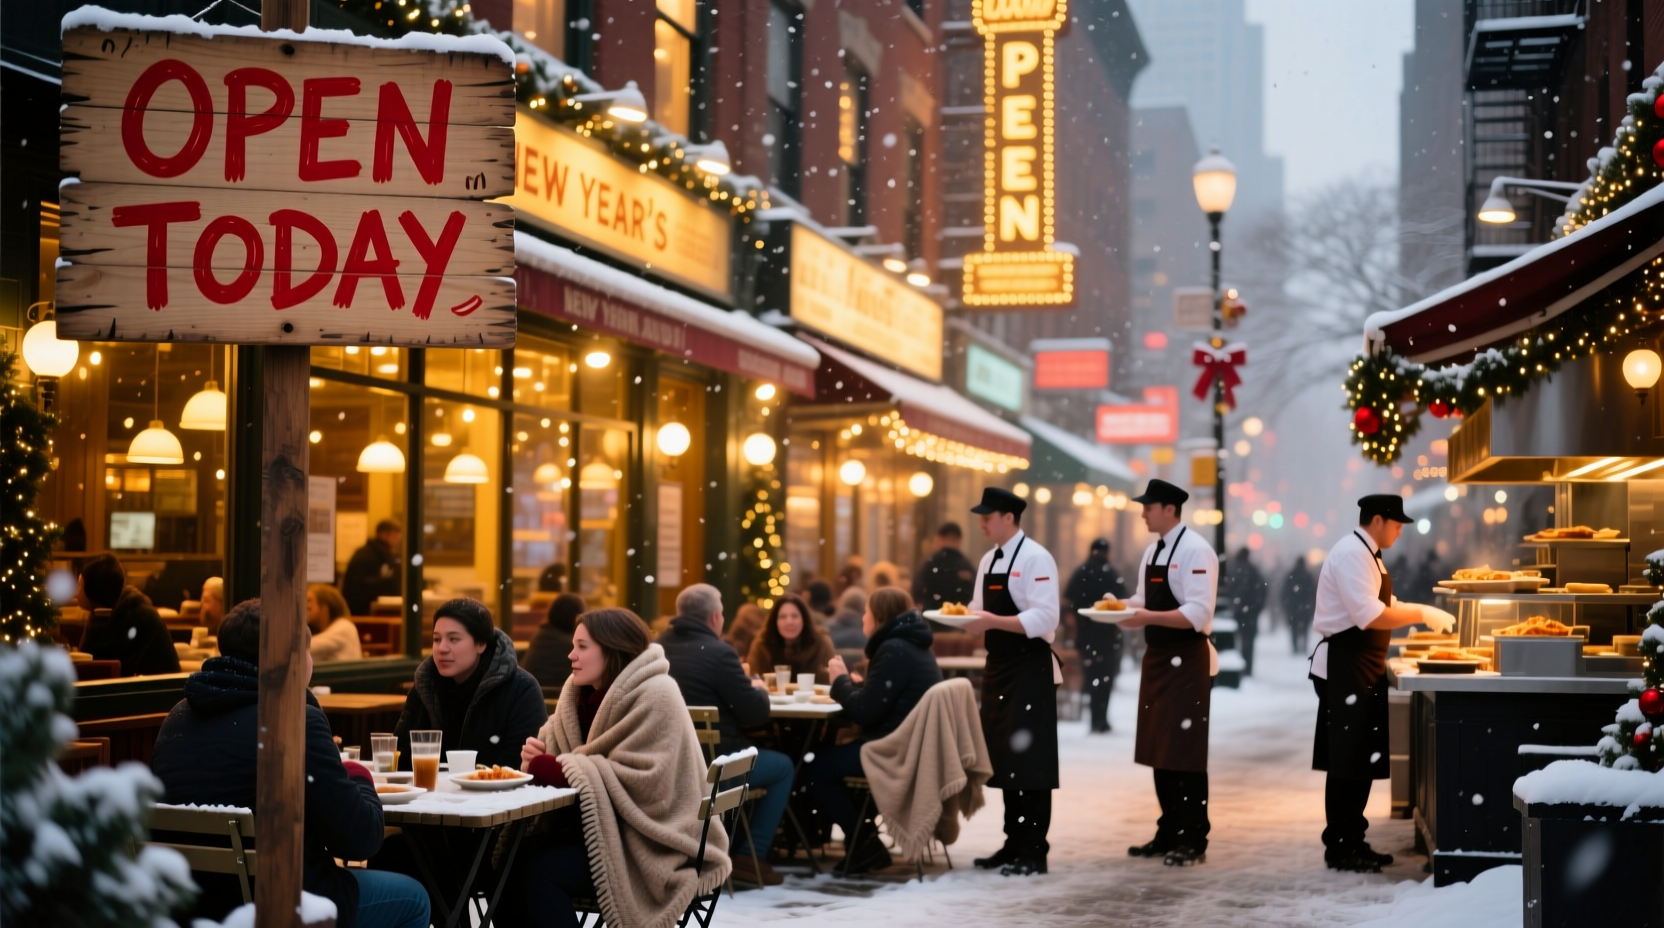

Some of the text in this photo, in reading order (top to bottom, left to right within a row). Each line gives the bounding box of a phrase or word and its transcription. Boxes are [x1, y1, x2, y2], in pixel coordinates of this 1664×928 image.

[121, 58, 453, 186] OPEN
[515, 142, 569, 208] EW
[579, 172, 668, 251] YEAR'S
